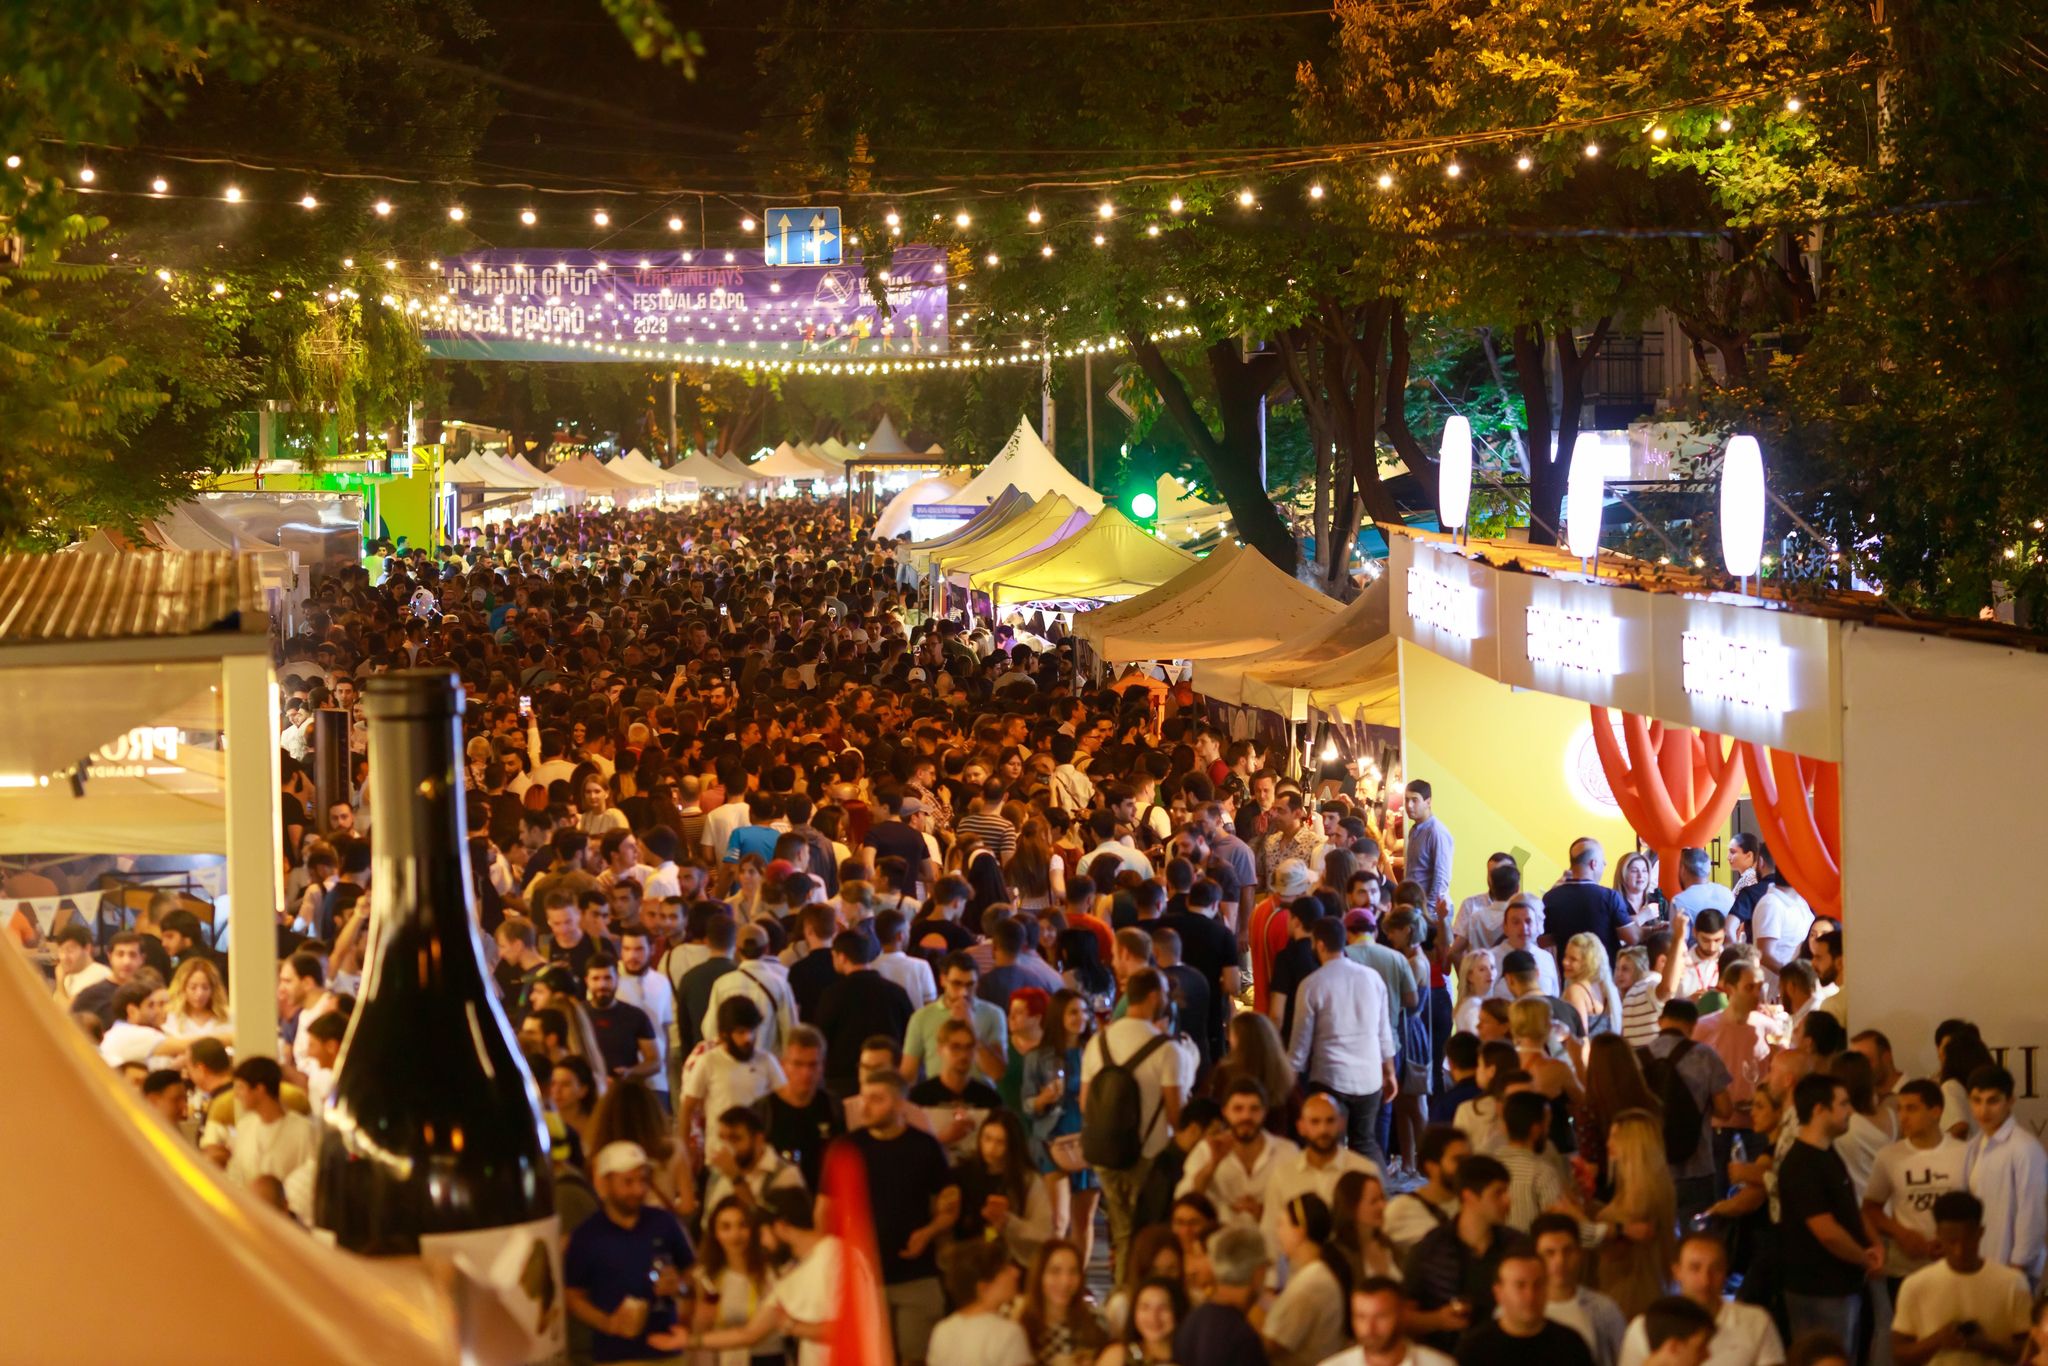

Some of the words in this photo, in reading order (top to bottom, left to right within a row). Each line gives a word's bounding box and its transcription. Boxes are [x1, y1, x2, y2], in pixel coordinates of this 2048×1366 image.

[633, 293, 692, 310] FESTIVAL
[697, 293, 706, 309] &
[709, 292, 745, 310] EXPO
[633, 316, 668, 334] 2023
